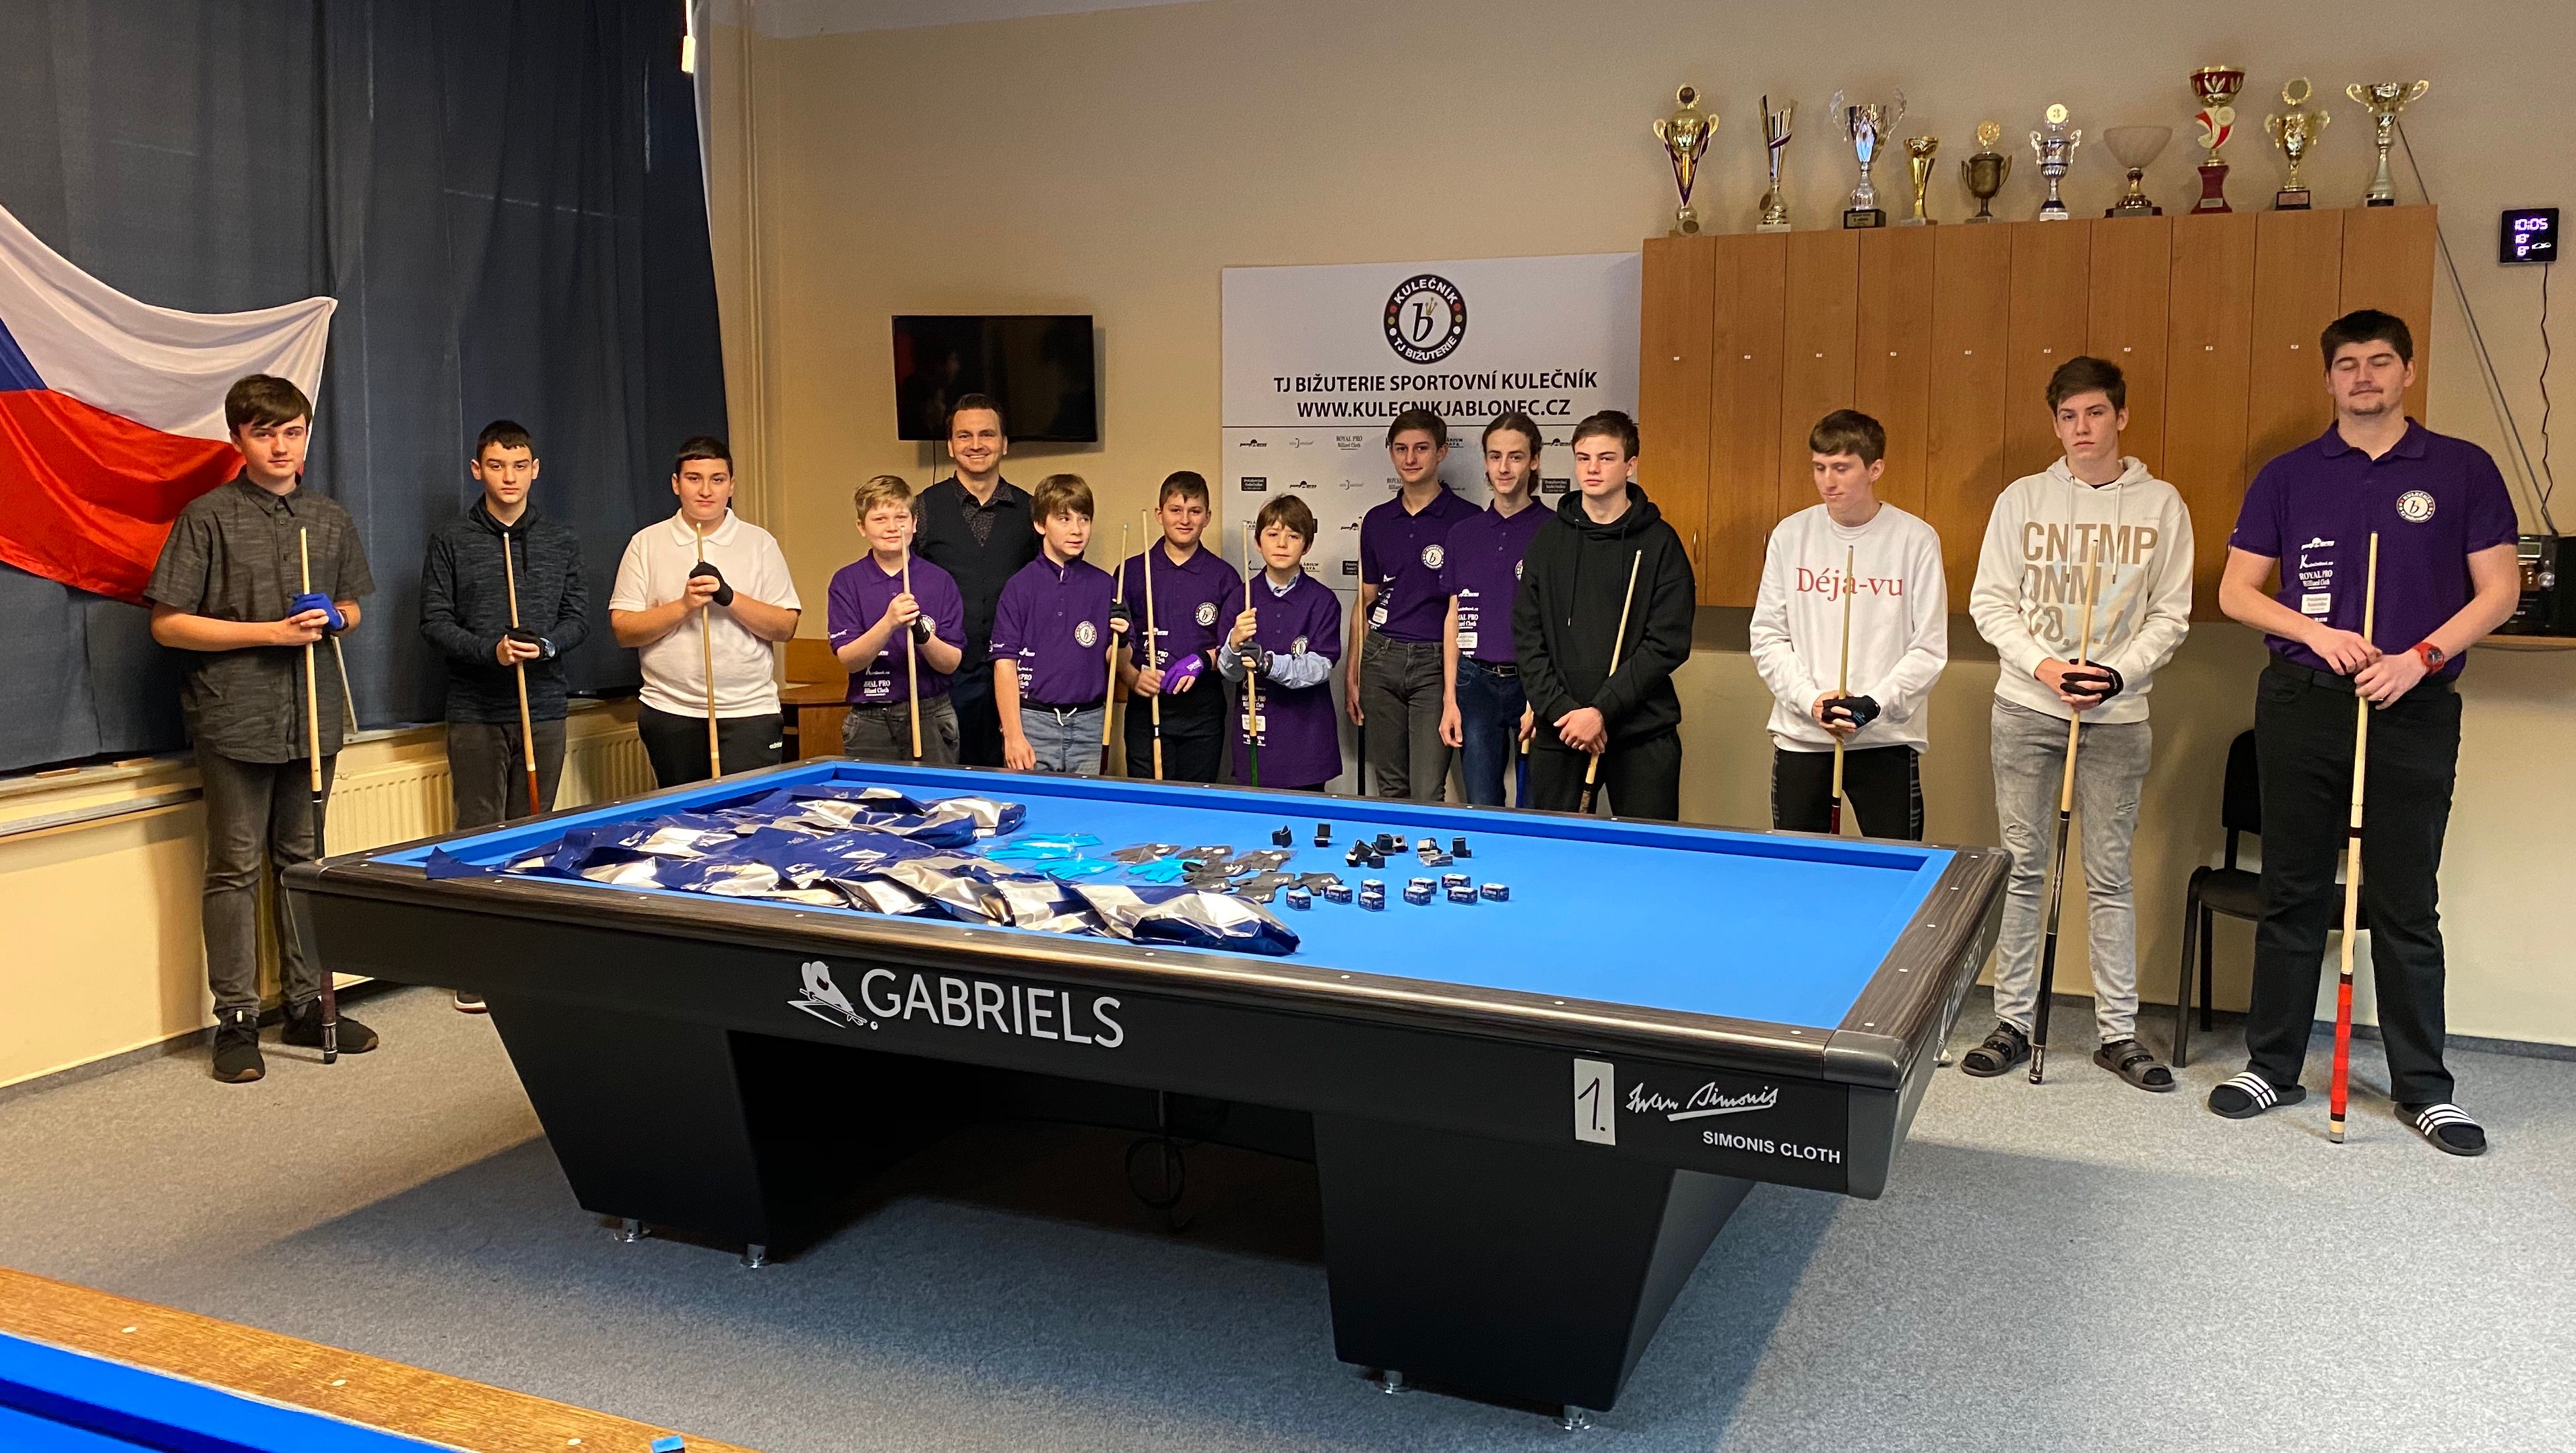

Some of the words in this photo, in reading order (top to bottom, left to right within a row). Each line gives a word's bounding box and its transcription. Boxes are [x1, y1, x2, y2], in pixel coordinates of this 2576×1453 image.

[2515, 218, 2548, 230] 10:05
[1394, 277, 1458, 305] KULEČNÍK
[1394, 337, 1406, 352] TJ
[1405, 336, 1457, 361] BIŽUTERIE
[1273, 377, 1291, 392] TJ
[1295, 373, 1385, 392] BIŽUTERIE
[1390, 370, 1497, 391] SPORTOVNÍ
[1502, 368, 1598, 389] KULEČNÍK
[2023, 521, 2158, 565] CNTMP
[2299, 571, 2321, 580] ROYAL
[860, 968, 1124, 1048] GABRIELS
[1578, 1077, 1606, 1132] 1.
[1685, 1082, 1779, 1110] Simonis
[1702, 1131, 1775, 1154] SIMONIS
[1780, 1143, 1841, 1164] CLOTH
